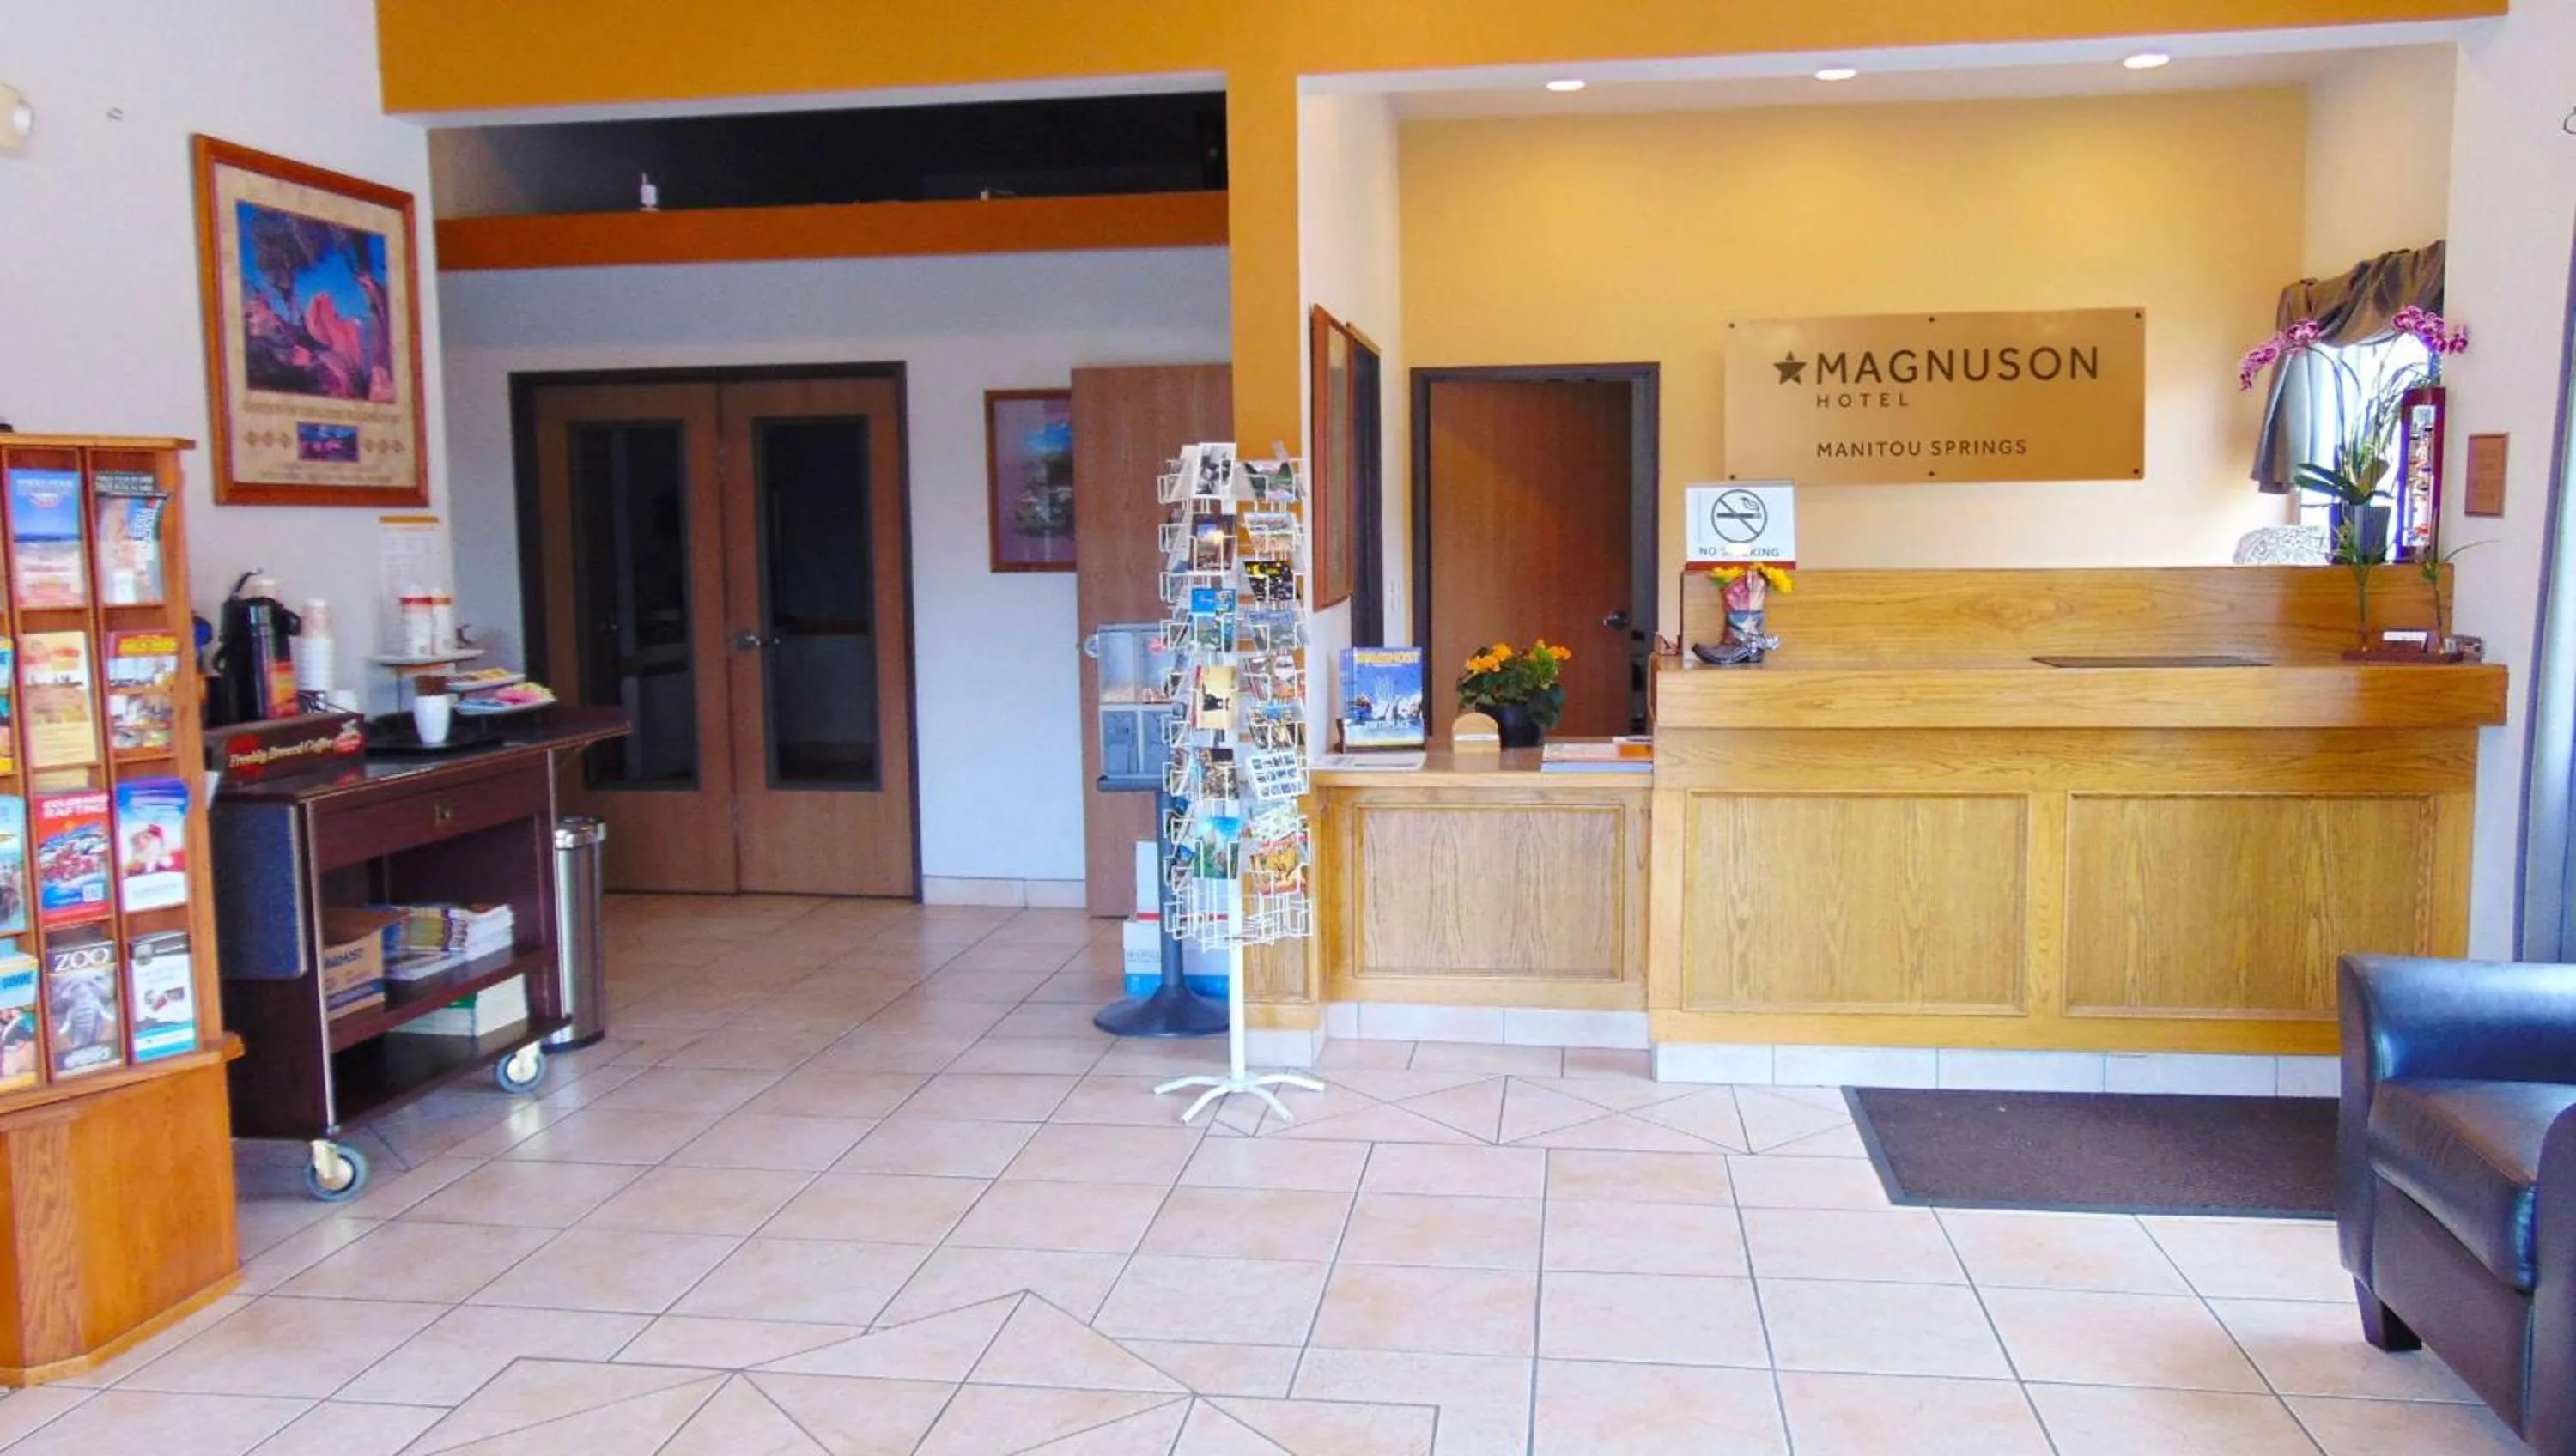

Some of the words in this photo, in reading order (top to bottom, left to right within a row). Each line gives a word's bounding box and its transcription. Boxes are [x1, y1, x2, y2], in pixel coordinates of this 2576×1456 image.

[1816, 345, 2099, 385] MAGNUSON
[1816, 391, 1911, 409] HOTEL
[1817, 440, 1922, 458] MANITOU
[1930, 438, 2028, 456] SPRINGS
[1698, 546, 1717, 557] NO
[54, 947, 109, 973] ZOO
